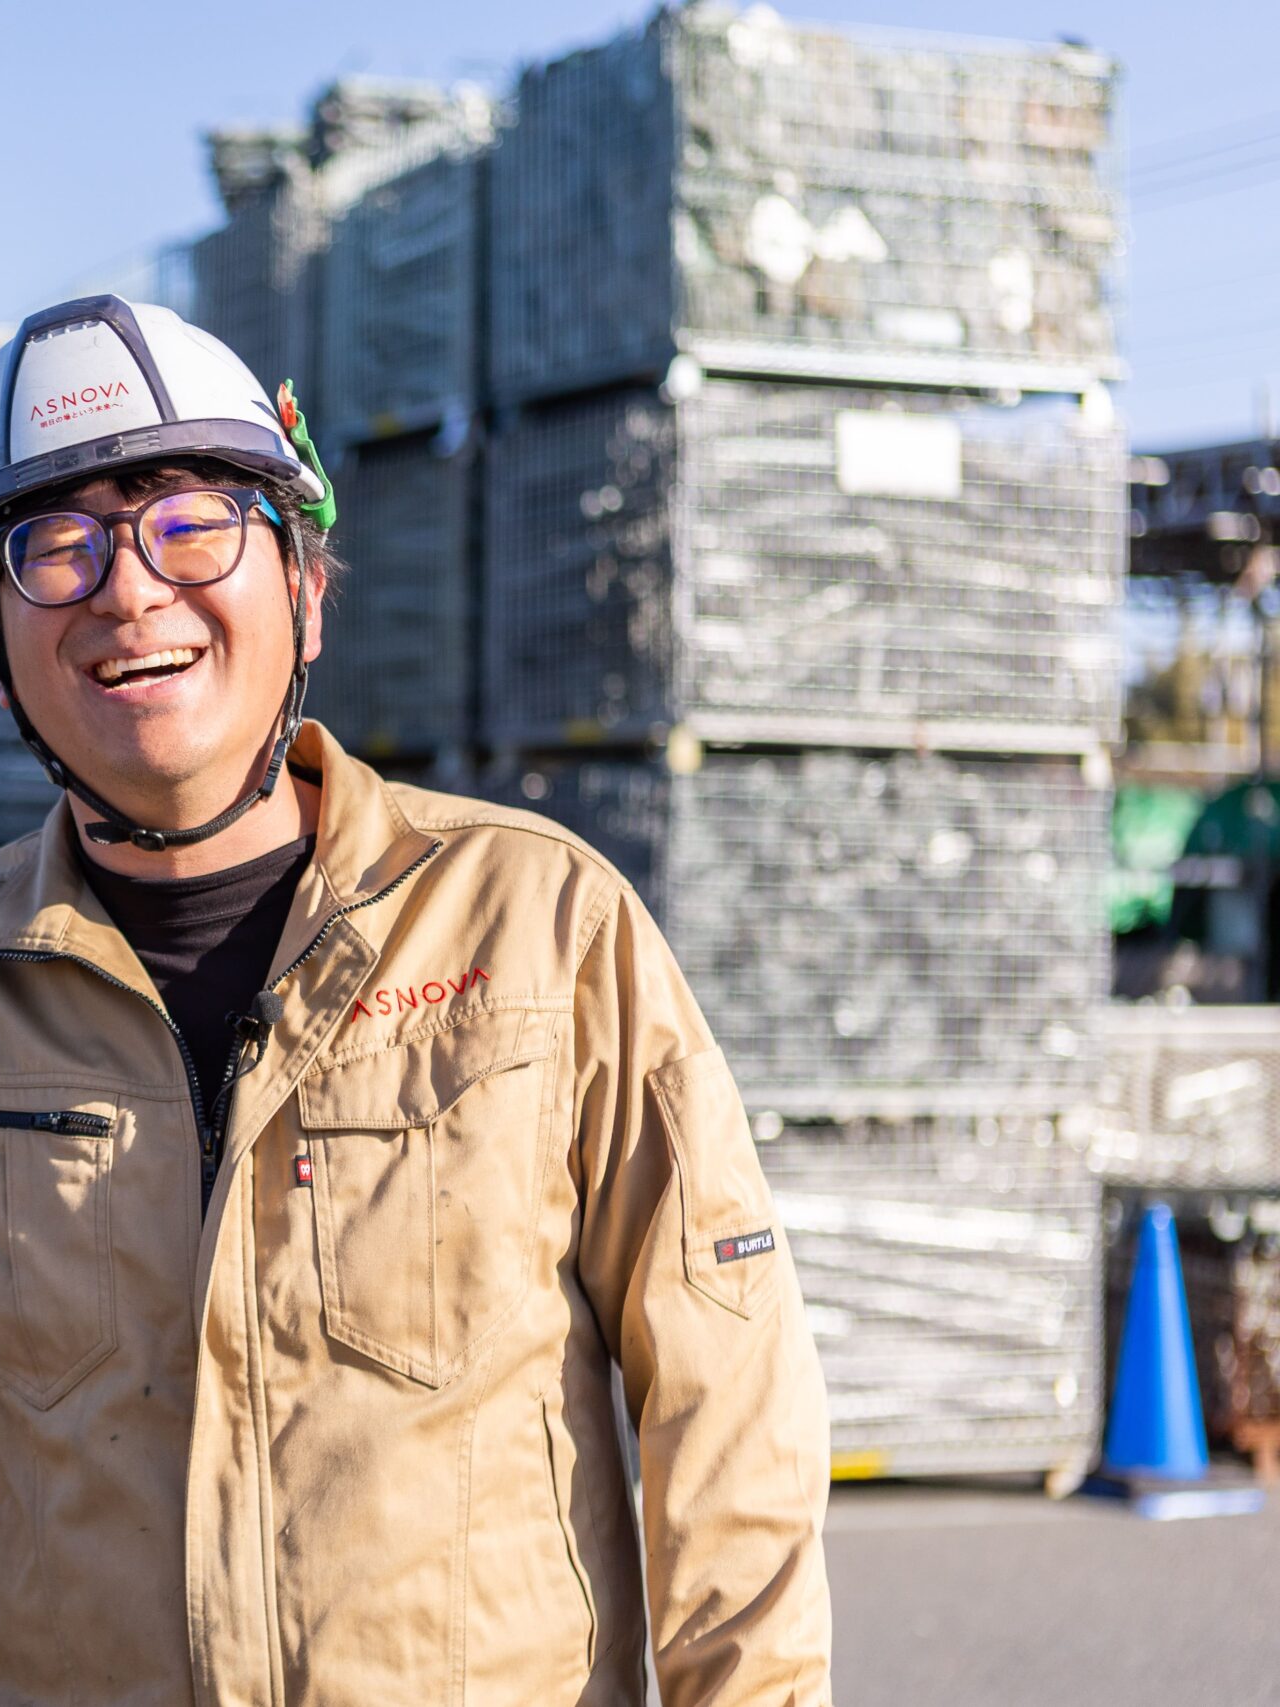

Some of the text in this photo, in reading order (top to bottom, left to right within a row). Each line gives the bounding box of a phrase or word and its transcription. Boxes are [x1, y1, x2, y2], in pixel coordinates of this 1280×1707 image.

[30, 381, 130, 421] ASNOVA
[351, 967, 491, 1023] ASNOVA
[737, 1234, 773, 1254] BURTLE
